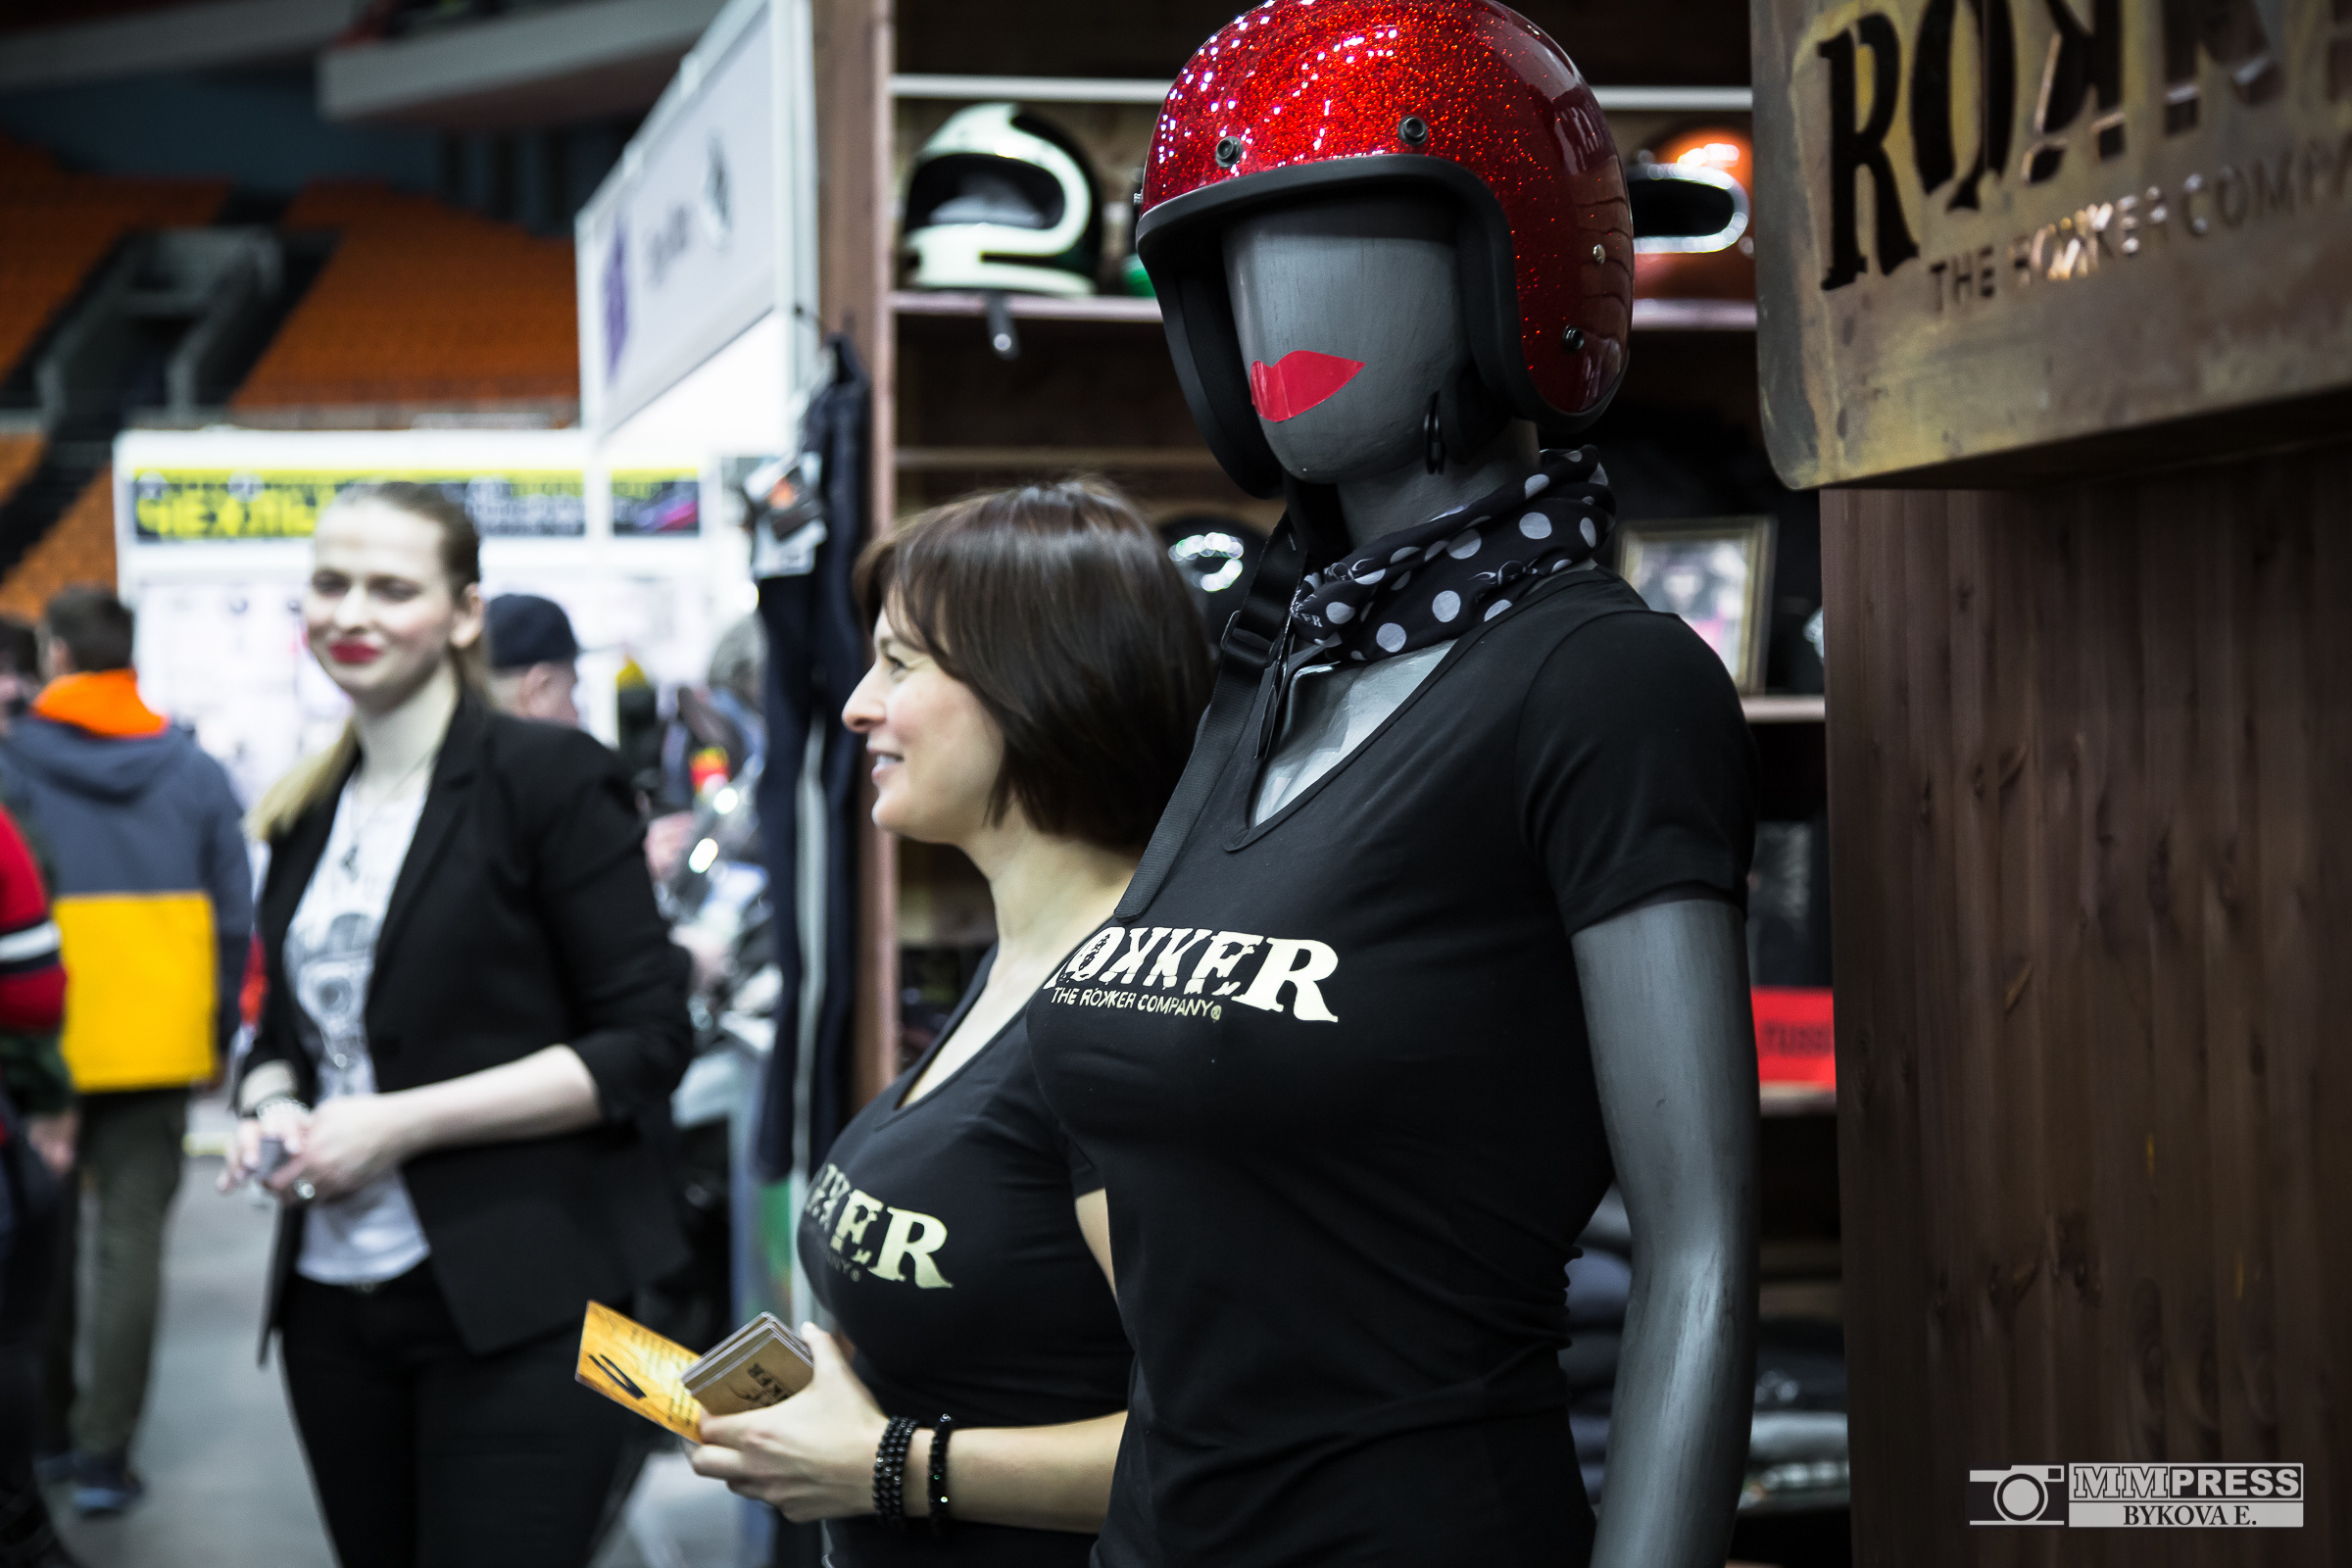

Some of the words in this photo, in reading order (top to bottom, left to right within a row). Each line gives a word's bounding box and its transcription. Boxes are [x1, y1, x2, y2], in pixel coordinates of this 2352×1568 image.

[1930, 245, 1995, 314] THE
[1042, 926, 1339, 1023] OKKER
[1051, 987, 1080, 1005] THE
[1079, 987, 1138, 1009] ROKKER
